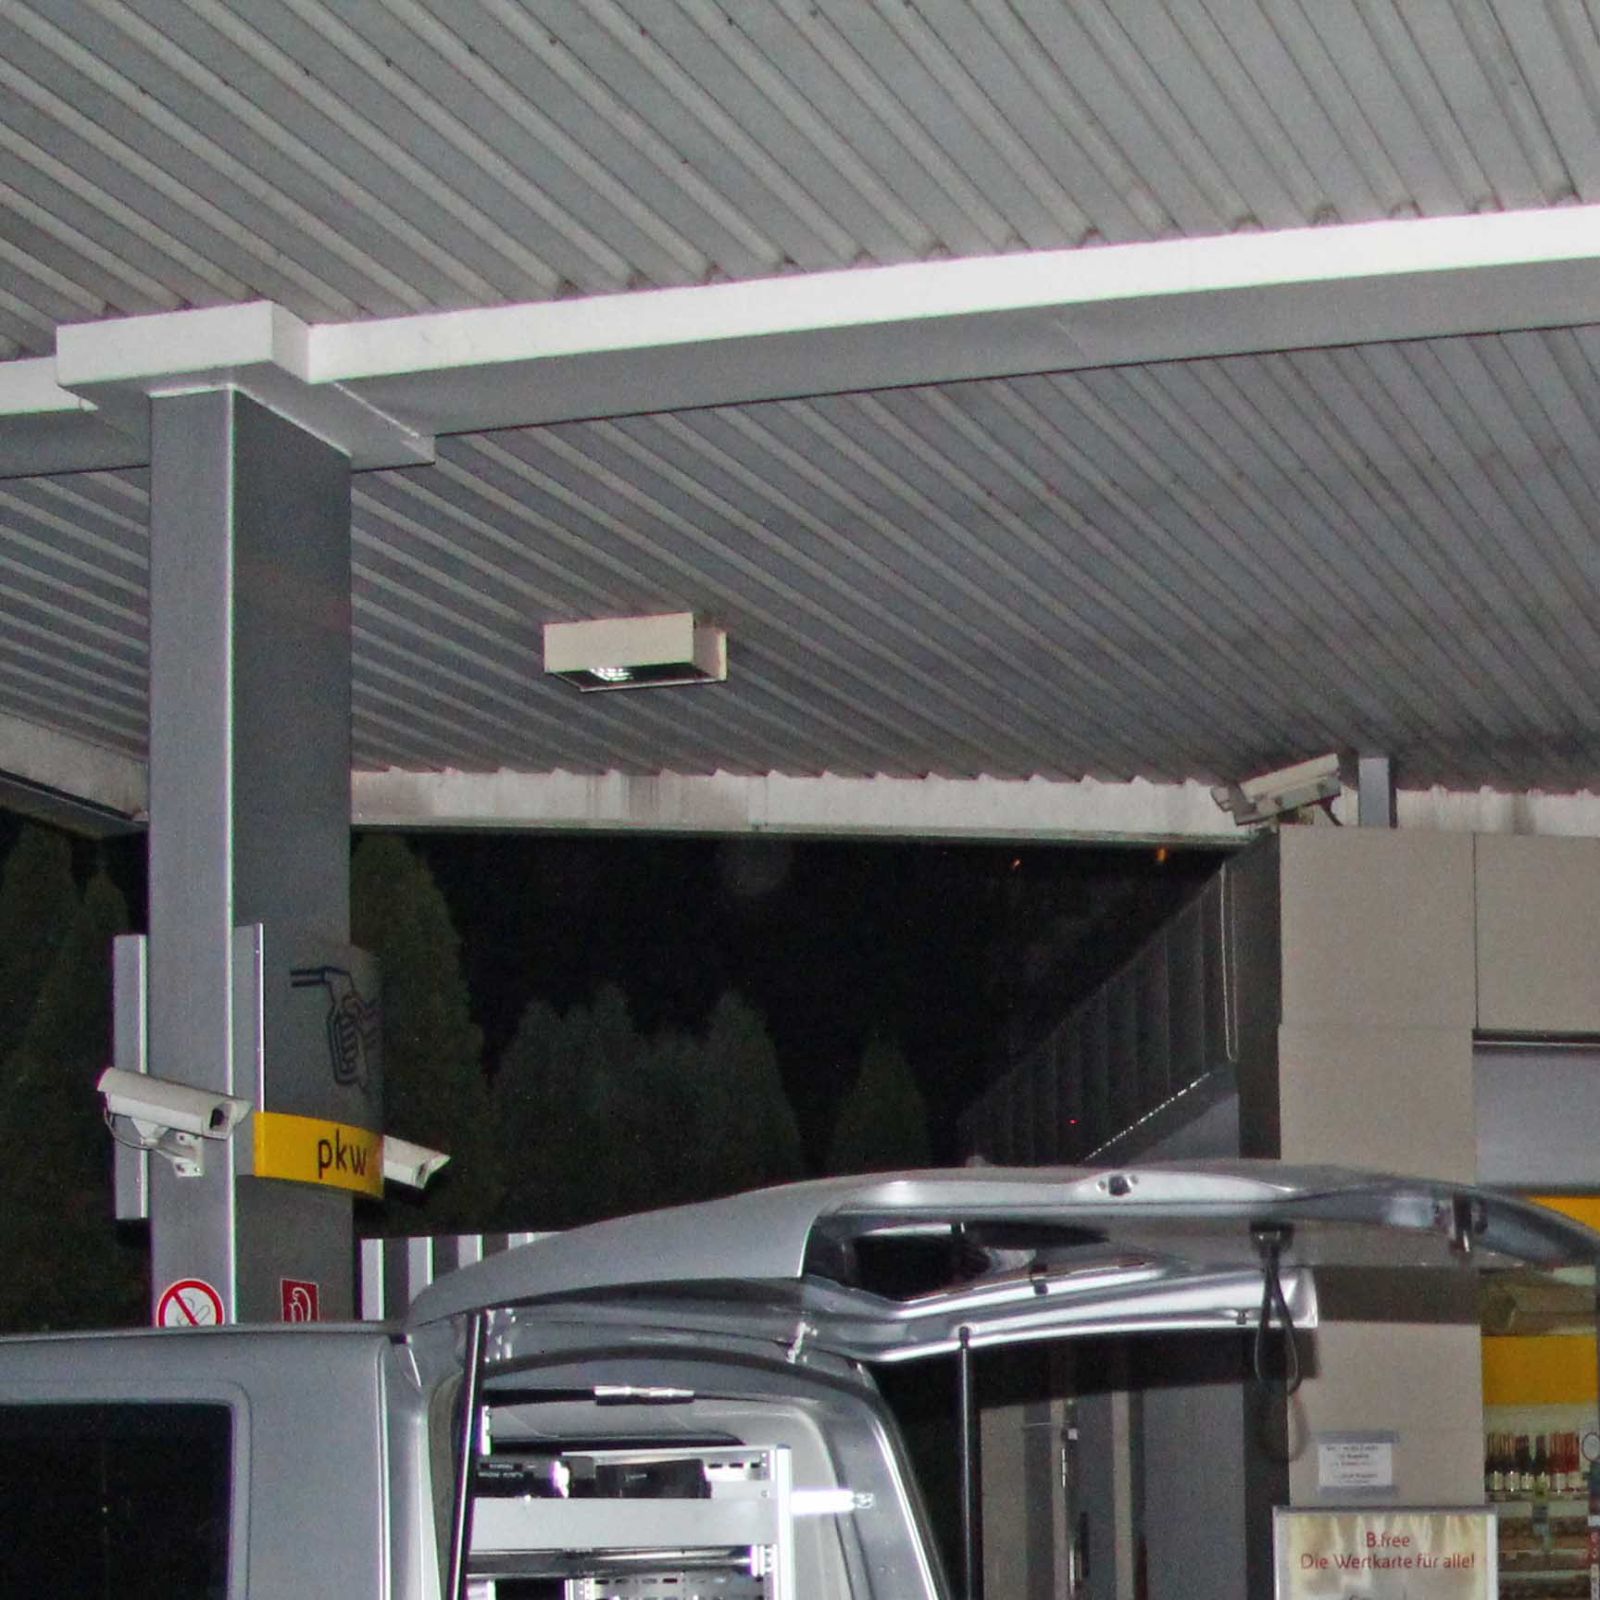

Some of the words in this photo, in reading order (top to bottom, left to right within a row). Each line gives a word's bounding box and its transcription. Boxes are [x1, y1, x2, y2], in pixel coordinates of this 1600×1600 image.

[318, 1128, 367, 1180] pkw
[1366, 1532, 1411, 1548] B.free
[1301, 1553, 1328, 1569] Die
[1333, 1553, 1413, 1569] Wertkarte
[1416, 1553, 1438, 1569] für
[1443, 1553, 1475, 1569] alle!
